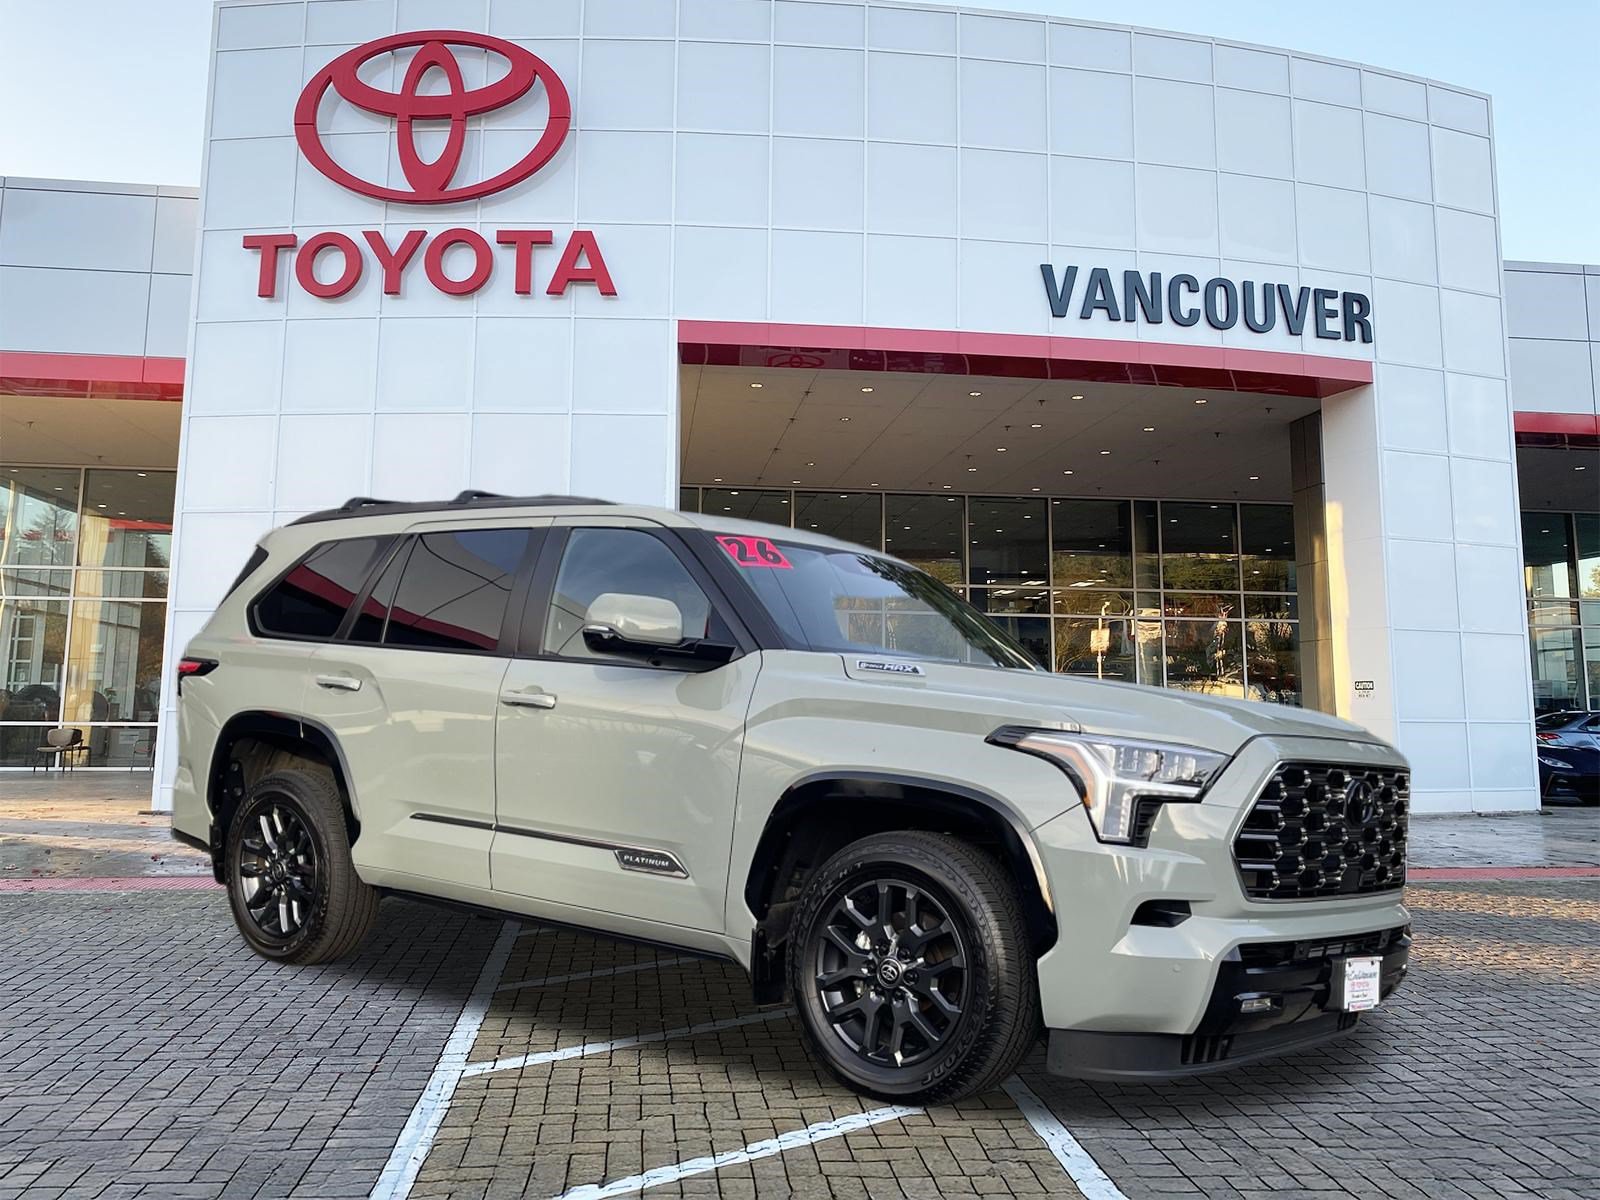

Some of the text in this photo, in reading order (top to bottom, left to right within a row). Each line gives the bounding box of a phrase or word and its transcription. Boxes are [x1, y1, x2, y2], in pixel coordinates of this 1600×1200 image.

[243, 228, 618, 298] TOYOTA
[1040, 264, 1373, 343] VANCOUVER
[723, 538, 782, 564] 26
[624, 855, 669, 866] PLATINUM
